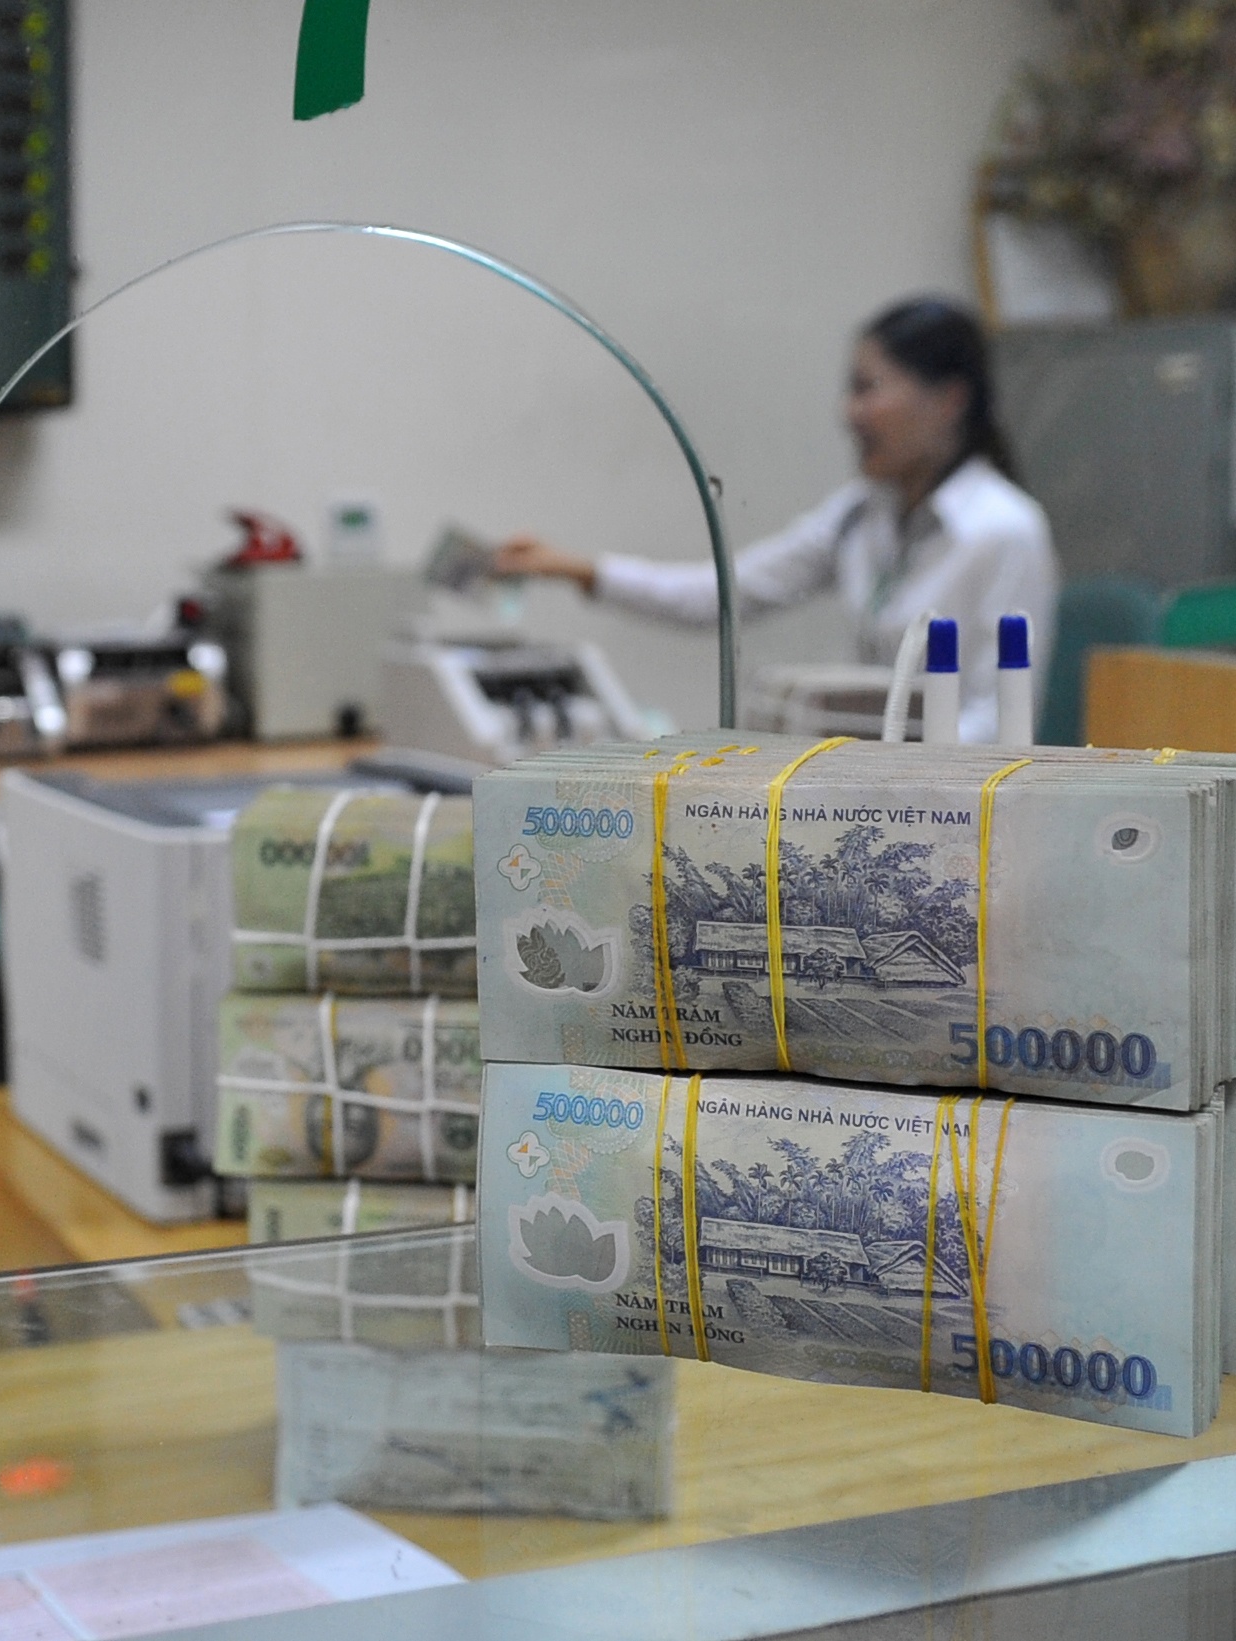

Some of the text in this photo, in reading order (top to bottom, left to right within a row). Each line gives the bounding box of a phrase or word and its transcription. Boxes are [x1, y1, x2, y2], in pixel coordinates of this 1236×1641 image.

[685, 801, 734, 819] NGÂN
[792, 804, 828, 822] NHÀ
[832, 804, 883, 823] NƯỚC
[887, 805, 927, 828] VIỆT
[930, 810, 972, 825] NAM
[610, 1000, 656, 1020] NĂM
[684, 1026, 743, 1047] ĐỒNG
[695, 1097, 741, 1116] NGÂN
[745, 1100, 793, 1121] HÀNG
[797, 1106, 834, 1125] NHÀ
[839, 1110, 890, 1130] NƯỚC
[894, 1115, 934, 1137] VIỆT
[615, 1291, 724, 1319] NĂM TRM
[615, 1316, 681, 1335] NGHN
